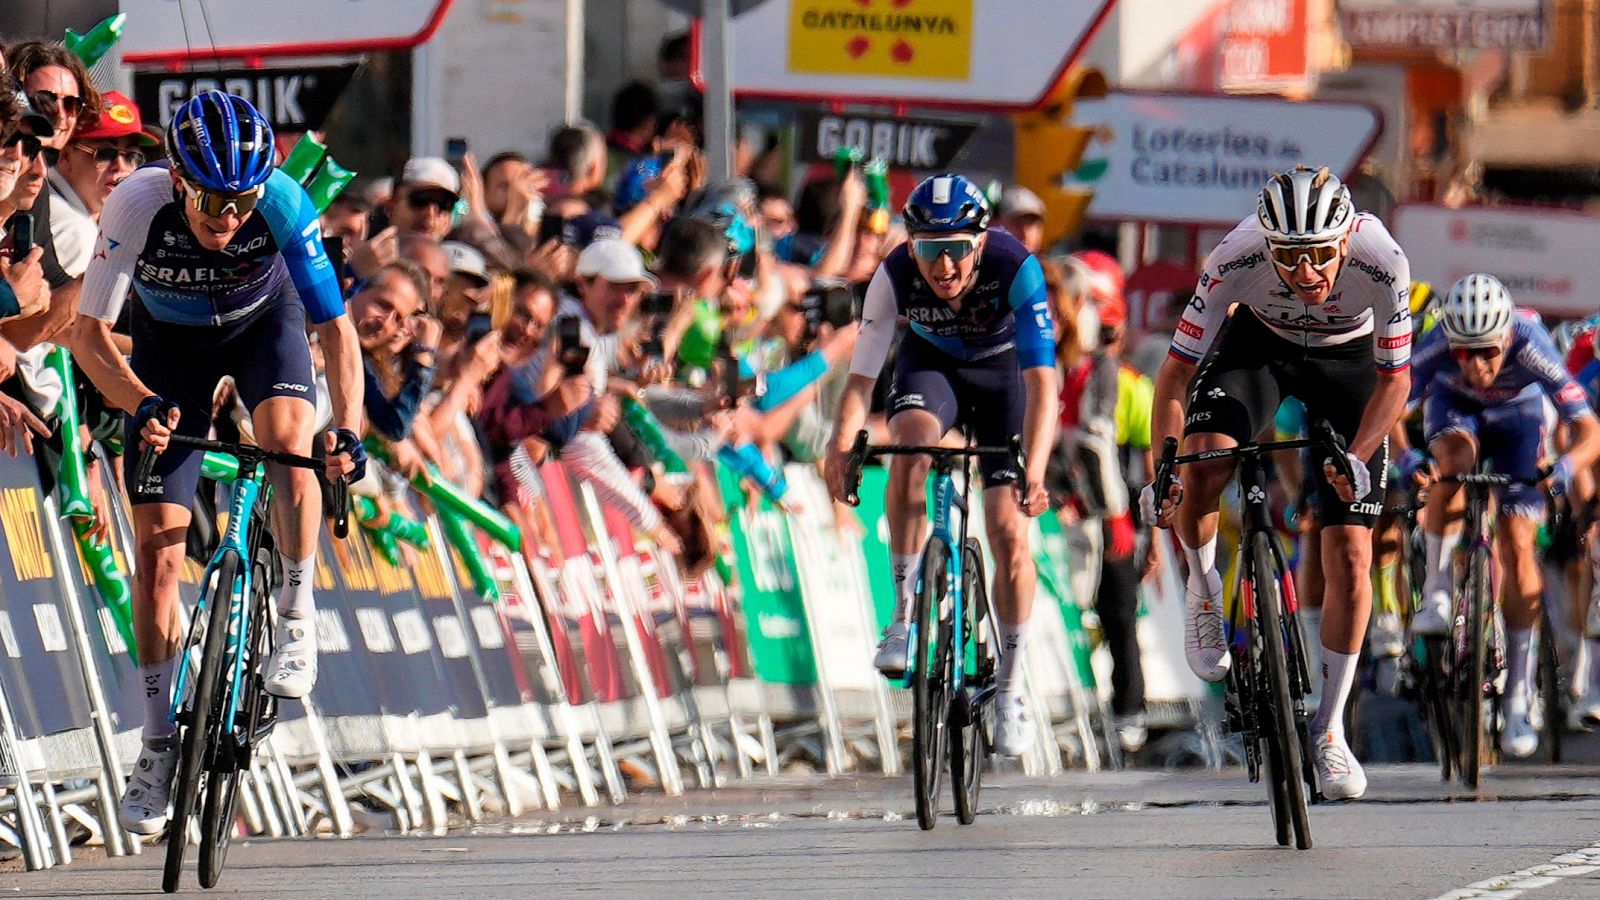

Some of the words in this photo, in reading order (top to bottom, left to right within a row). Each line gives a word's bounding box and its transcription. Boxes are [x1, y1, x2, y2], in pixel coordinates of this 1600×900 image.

[802, 10, 957, 35] CATALUNYA
[817, 117, 938, 167] GOBIK
[1131, 122, 1271, 157] Loteries
[1130, 156, 1269, 189] Catalun
[138, 259, 220, 284] ISRAEL
[1218, 251, 1266, 276] presight
[1348, 257, 1396, 288] presight
[229, 486, 247, 542] FACTOR
